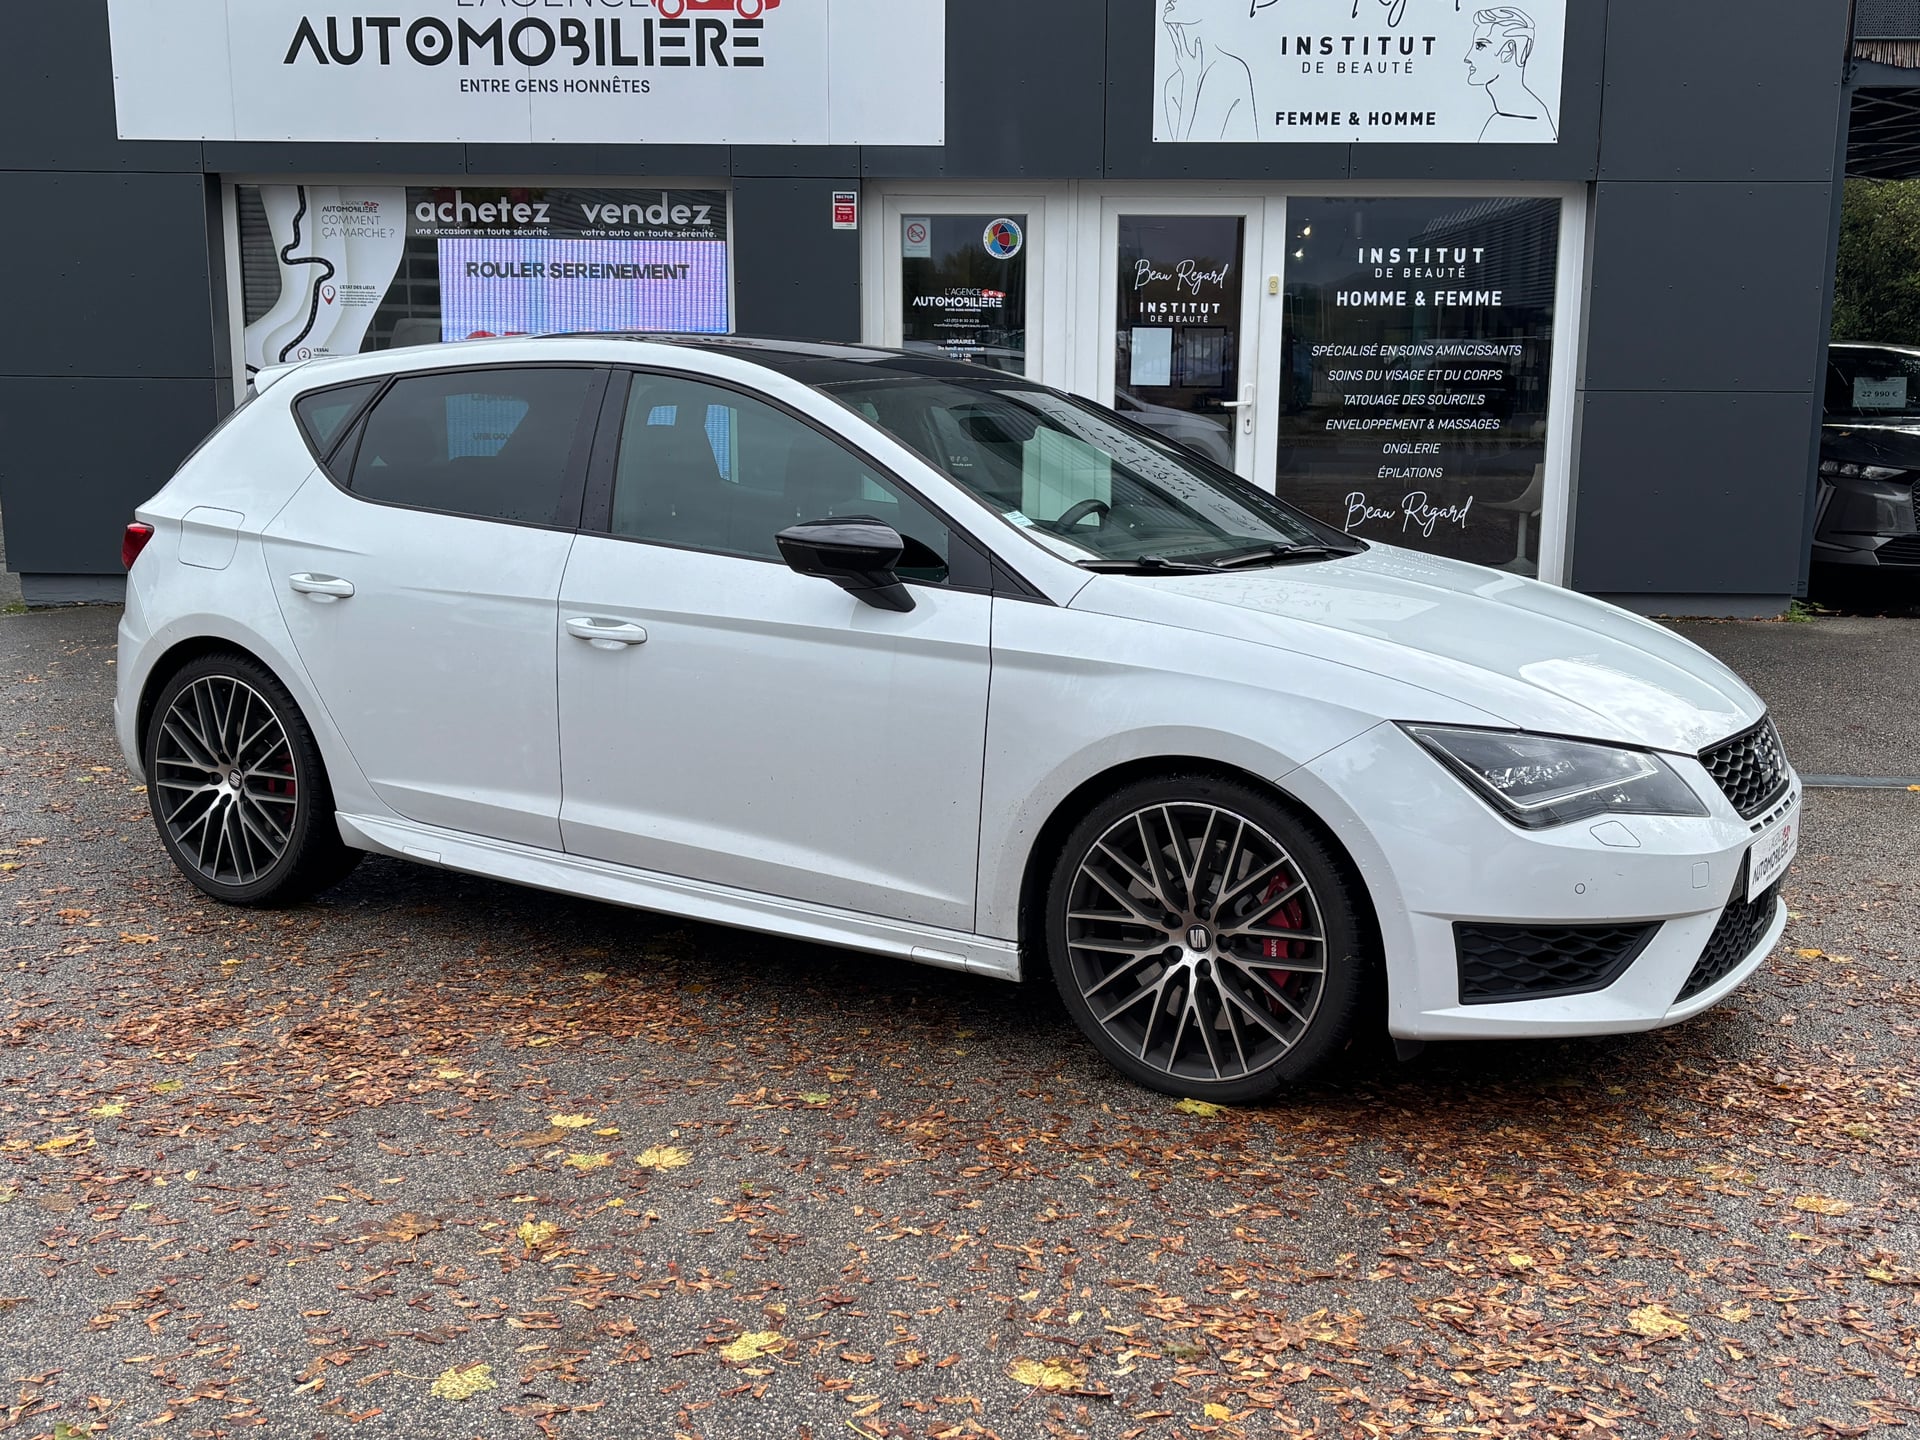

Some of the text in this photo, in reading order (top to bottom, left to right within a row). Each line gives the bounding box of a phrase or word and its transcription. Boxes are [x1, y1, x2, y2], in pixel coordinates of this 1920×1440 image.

[283, 16, 764, 67] AUTOMOBILIERE
[1281, 36, 1437, 56] INSTITUT
[1302, 59, 1414, 74] DE BEAUTÉ
[460, 76, 650, 94] ENTRE GENS HONNÊTES
[1276, 112, 1436, 126] FEMME & HOMME
[415, 190, 550, 223] achetez
[581, 192, 712, 225] vendez
[321, 215, 381, 225] COMMENT
[322, 227, 395, 239] ÇA MARCHE ?
[434, 227, 471, 235] occasion
[487, 227, 510, 235] toute
[513, 227, 550, 236] sécurité.
[581, 229, 605, 237] votre
[608, 229, 630, 237] auto
[648, 229, 673, 238] toute
[676, 229, 717, 238] sérénité.
[1358, 248, 1484, 264] INSTITUT
[466, 262, 689, 280] ROULER SEREINEMENT
[1134, 259, 1229, 295] Beau Regard
[1375, 265, 1466, 278] DE BEAUTÉ
[945, 288, 981, 296] L'AGENCE
[1336, 290, 1502, 306] HOMME & FEMME
[1140, 302, 1220, 313] INSTITUT
[1168, 314, 1209, 323] BEAUTÉ
[1311, 342, 1523, 356] SPÉCIALISÉ EN SOINS AMINCISSANTS
[1328, 370, 1503, 381] SOINS DU VISAGE ET DU CORPS
[1343, 394, 1486, 406] TATOUAGE DES SOURCILS
[1325, 419, 1501, 430] ENVELOPPEMENT & MASSAGES
[1382, 443, 1441, 454] ONGLERIE
[1377, 465, 1444, 478] ÉPILATIONS
[1344, 491, 1396, 532] Beau
[1401, 491, 1474, 537] Regard
